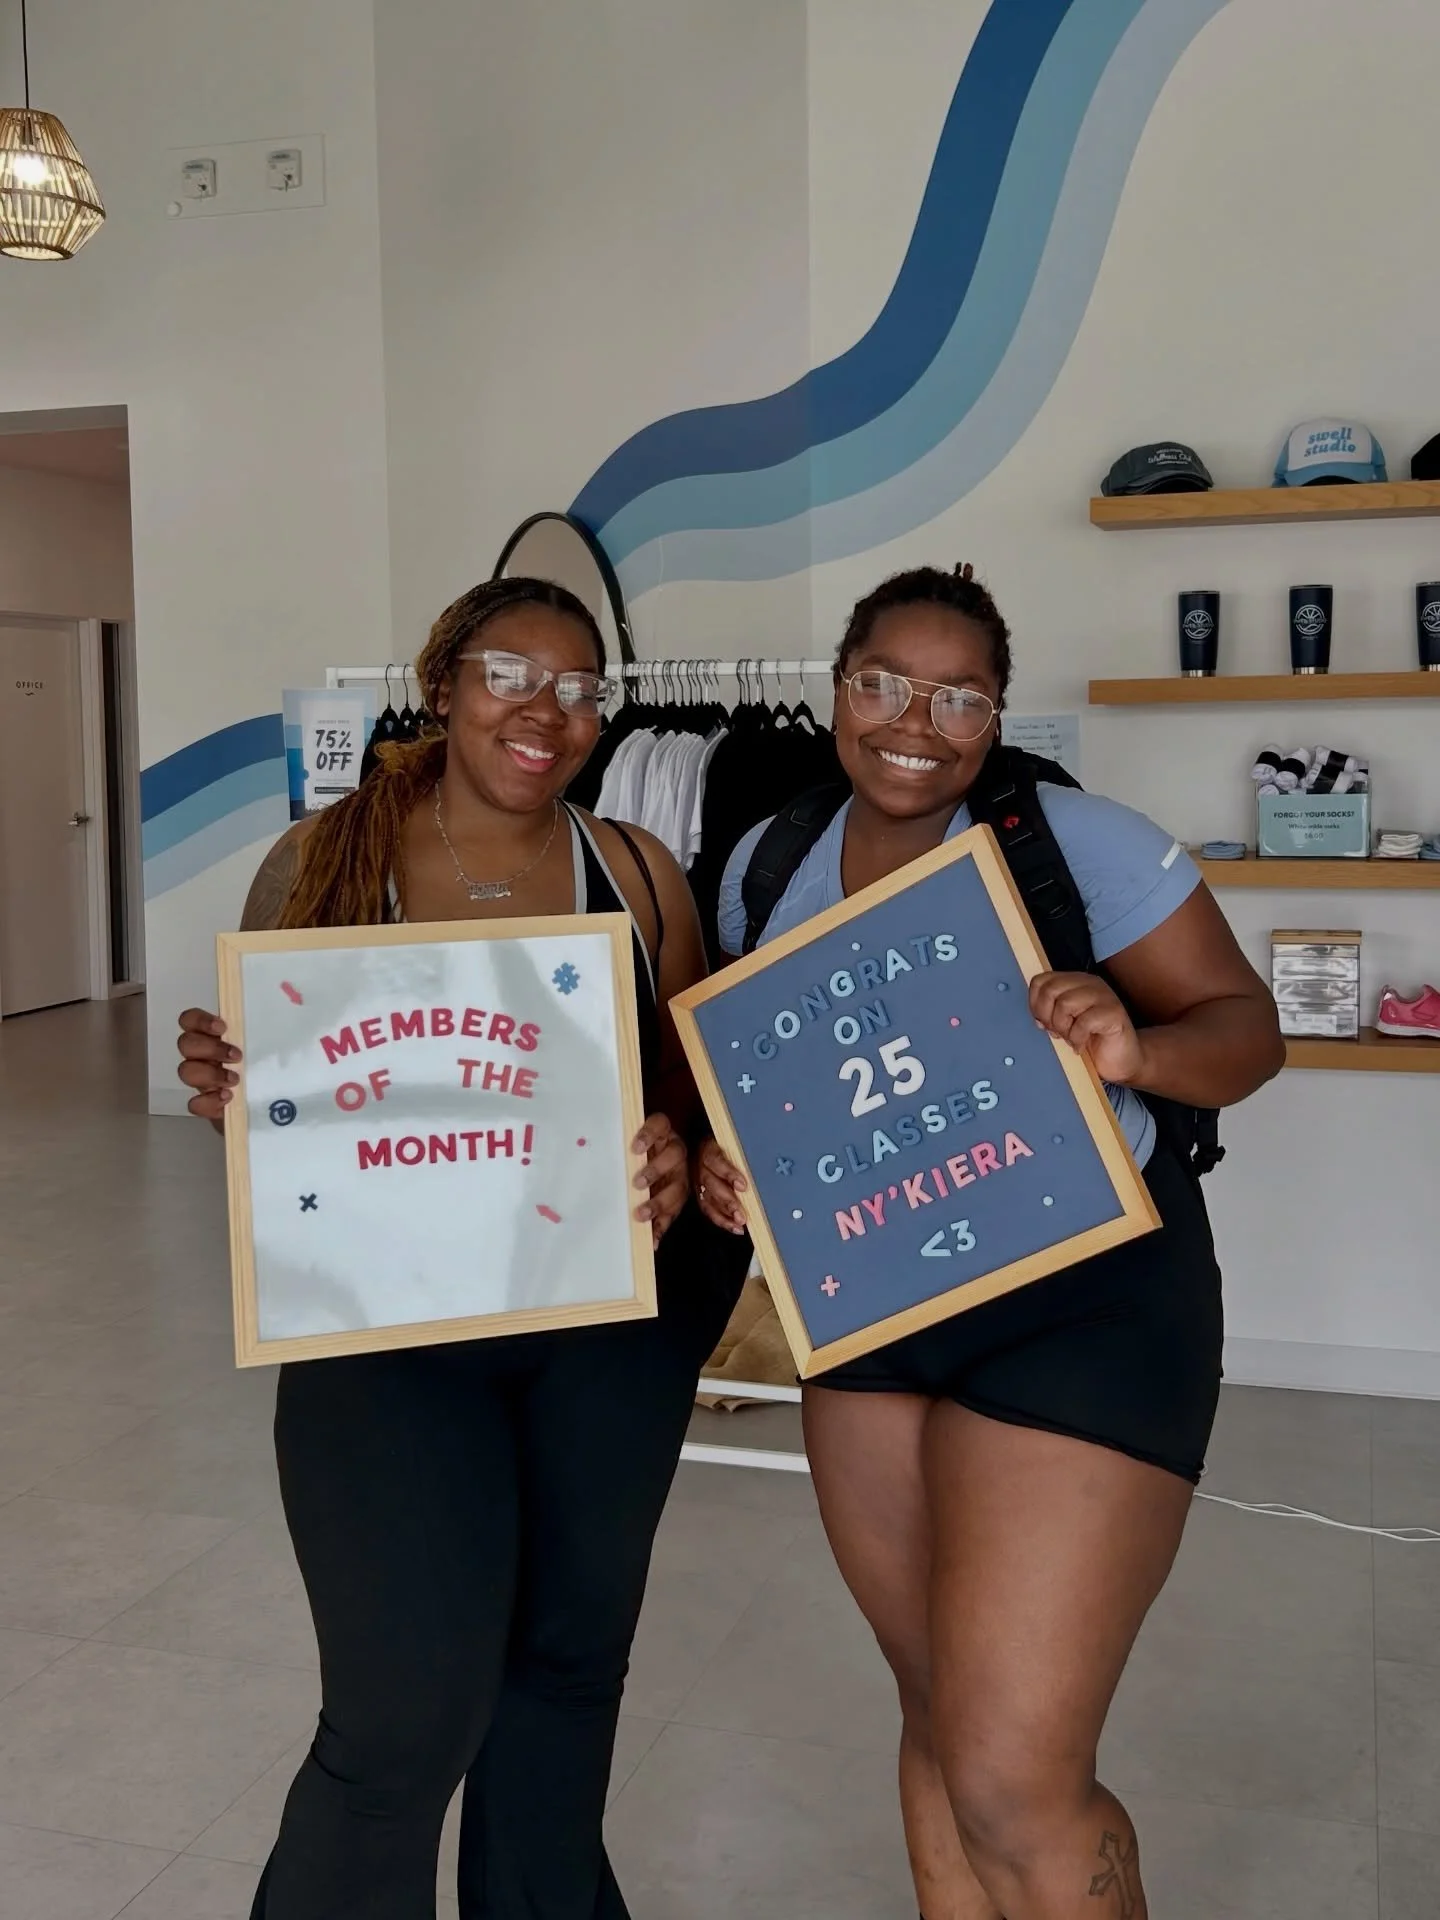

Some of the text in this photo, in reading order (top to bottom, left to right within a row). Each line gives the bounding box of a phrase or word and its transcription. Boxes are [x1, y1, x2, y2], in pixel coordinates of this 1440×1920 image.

[1303, 440, 1356, 457] studio
[1308, 426, 1352, 444] swell
[315, 729, 353, 749] 75%
[316, 751, 354, 771] OFF
[752, 933, 959, 1060] CONGRATS
[319, 1007, 541, 1065] MEMBERS
[833, 999, 891, 1045] ON
[335, 1058, 540, 1112] OF THE
[838, 1035, 927, 1118] 25
[357, 1123, 535, 1170] MONTH!
[816, 1079, 1000, 1184] CLASSES
[834, 1131, 1035, 1241] NY'KIERA
